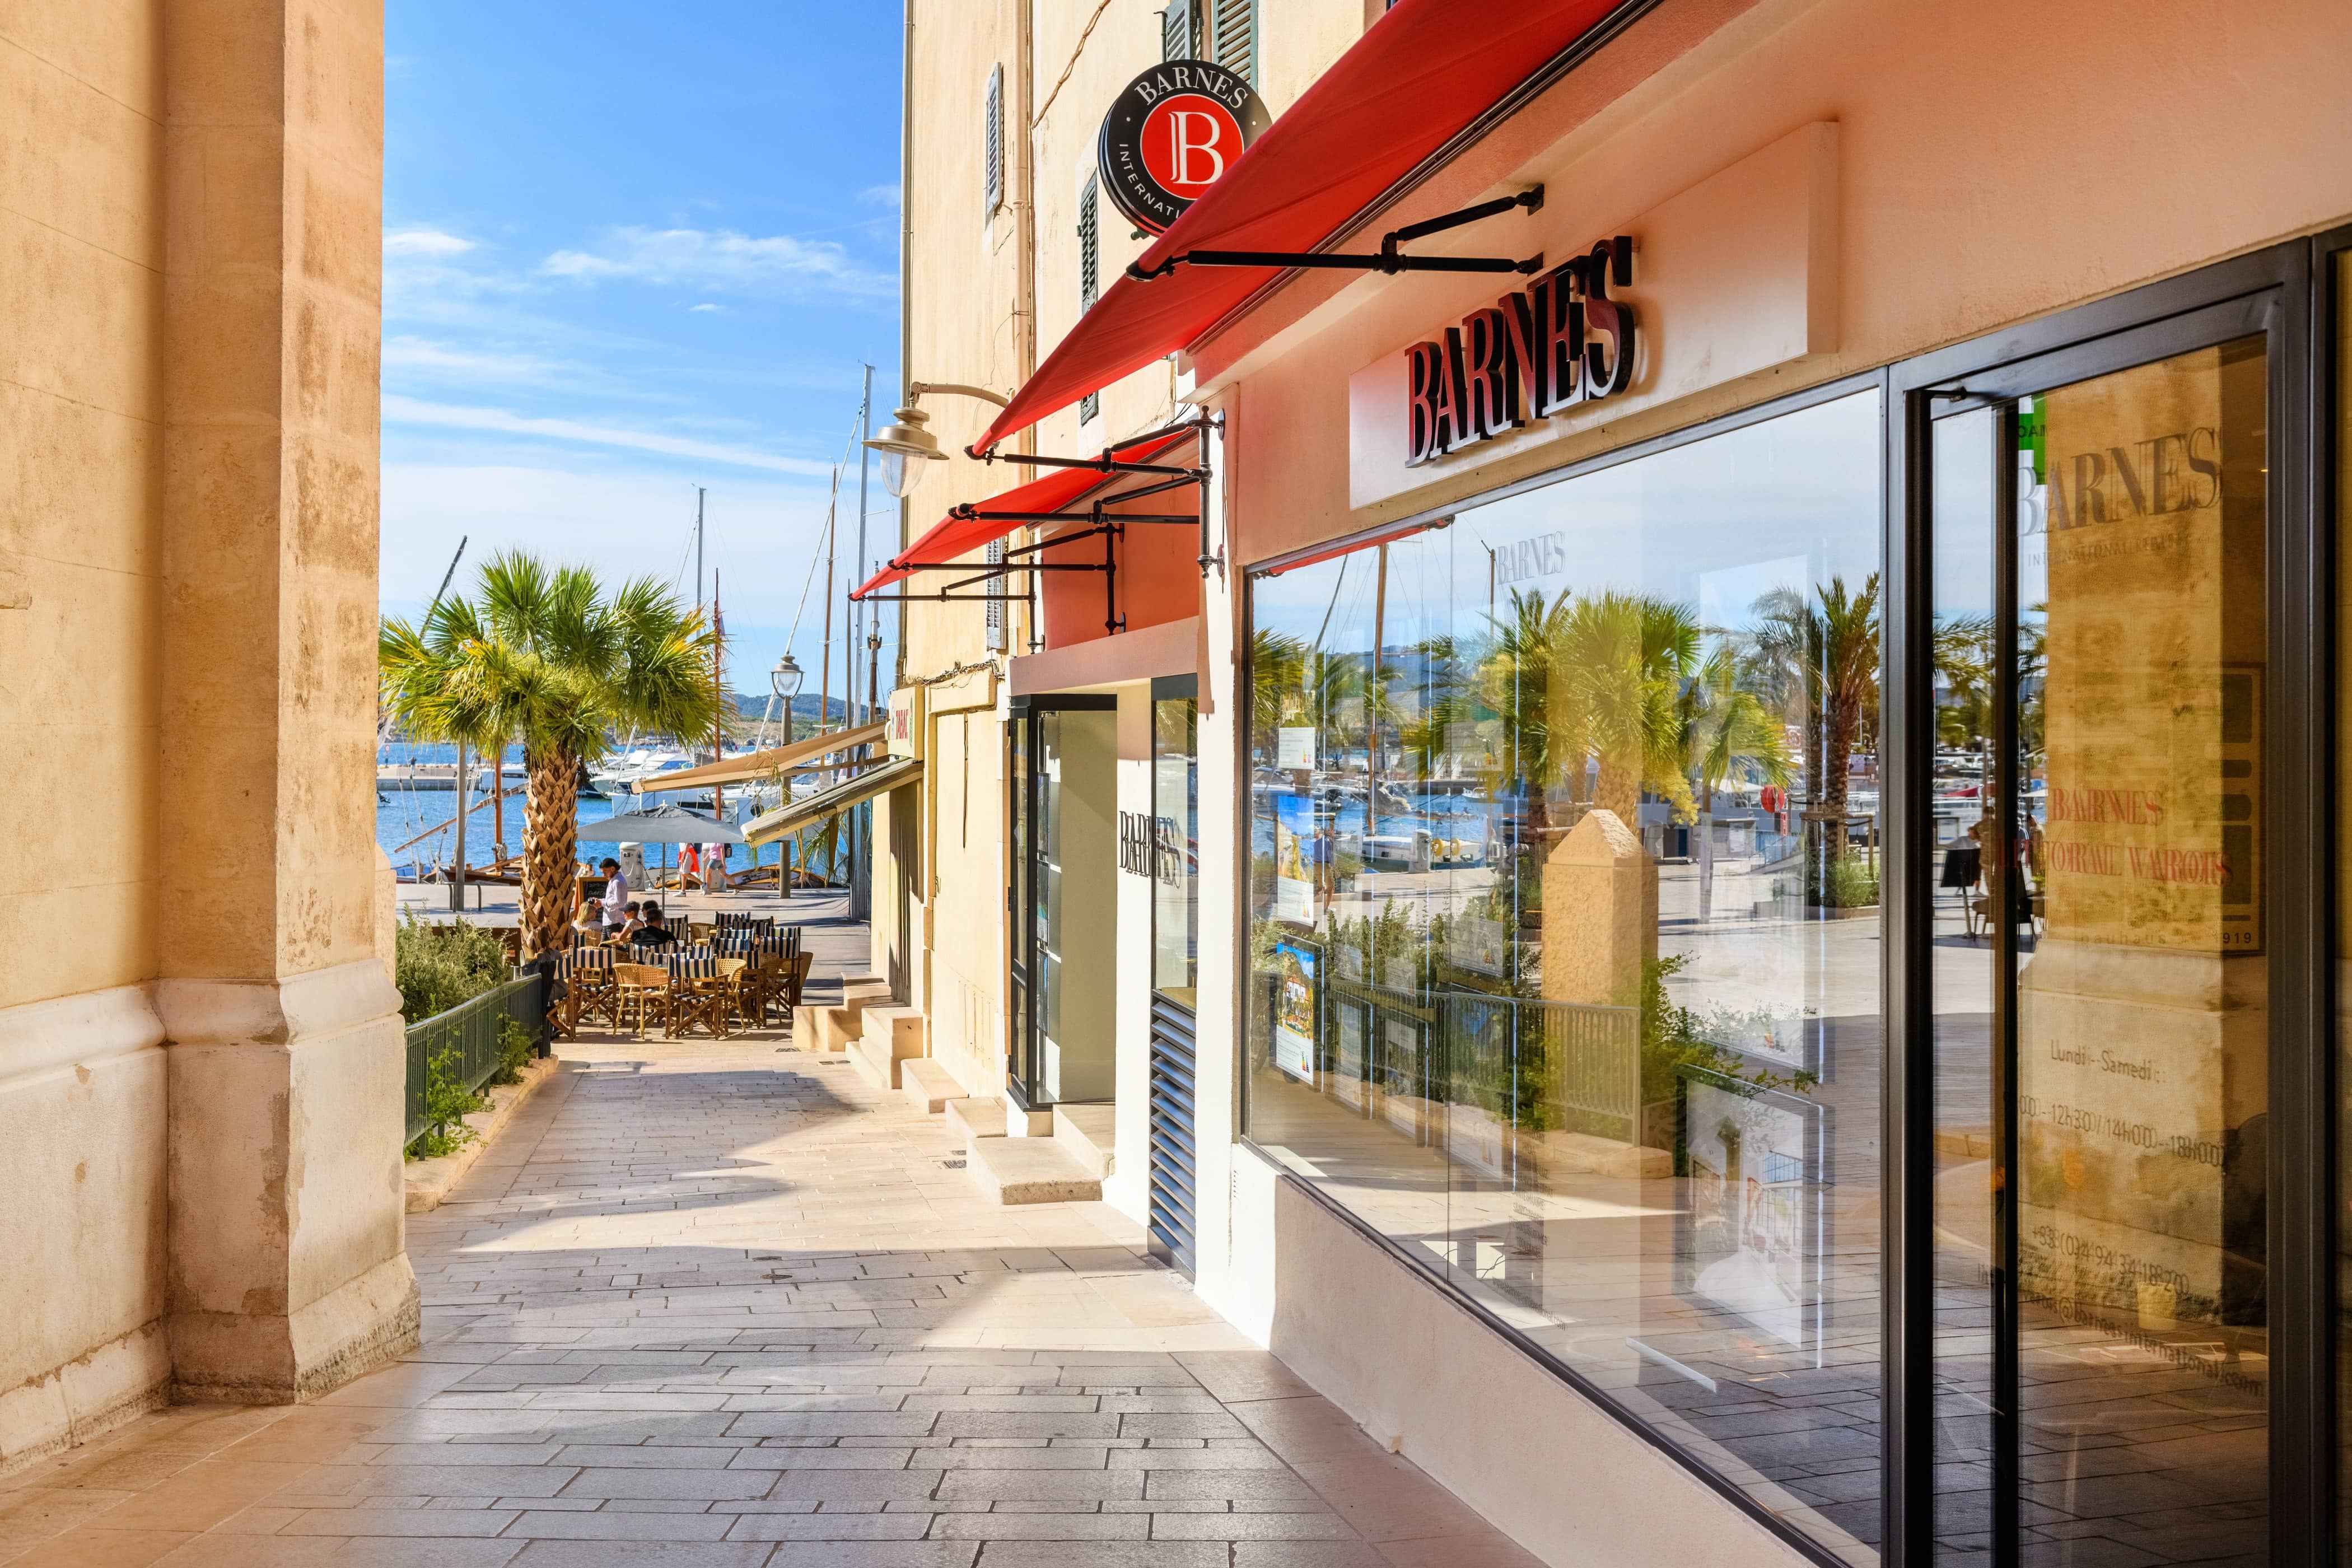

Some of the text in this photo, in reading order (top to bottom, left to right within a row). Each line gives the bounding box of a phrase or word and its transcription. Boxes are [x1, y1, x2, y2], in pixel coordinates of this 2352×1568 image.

[1134, 67, 1249, 109] BARNES
[1168, 111, 1224, 184] B
[1119, 143, 1180, 219] INTERNATI
[1404, 236, 1636, 468] BARNES
[2017, 427, 2222, 536] BARNES
[1497, 530, 1566, 585] BARNES
[2049, 788, 2164, 825] BARNES
[2222, 932, 2251, 944] 919
[2051, 1040, 2087, 1066] Lundi
[2101, 1050, 2151, 1081] Samedi
[2052, 1103, 2092, 1132] 12h30
